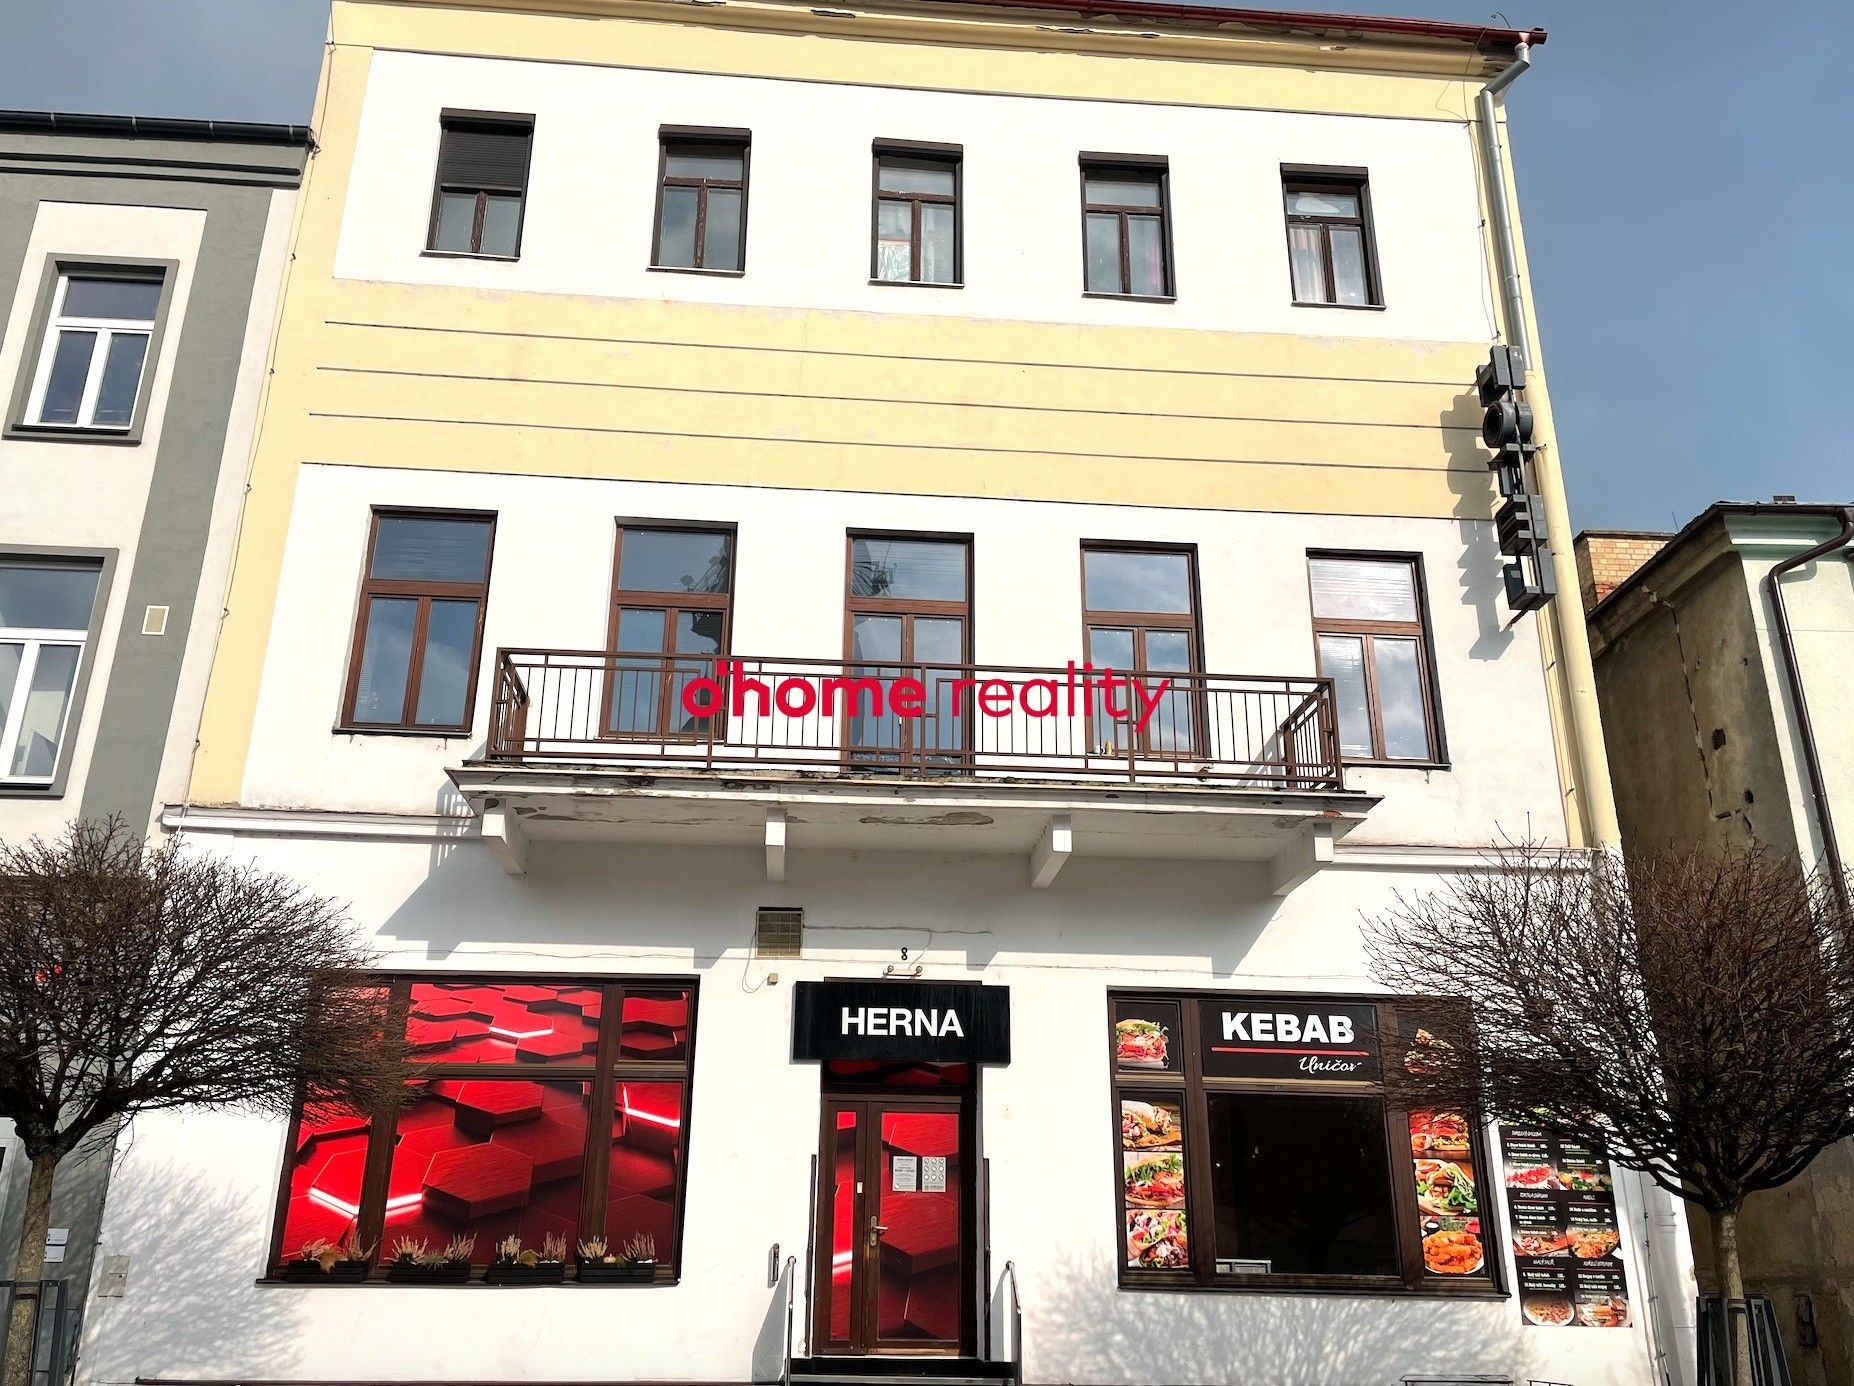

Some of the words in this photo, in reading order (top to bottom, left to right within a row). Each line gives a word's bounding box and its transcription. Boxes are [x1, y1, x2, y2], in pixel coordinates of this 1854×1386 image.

[901, 946, 908, 961] 8
[841, 1006, 965, 1038] HERNA
[1221, 1011, 1355, 1044] KEBAB
